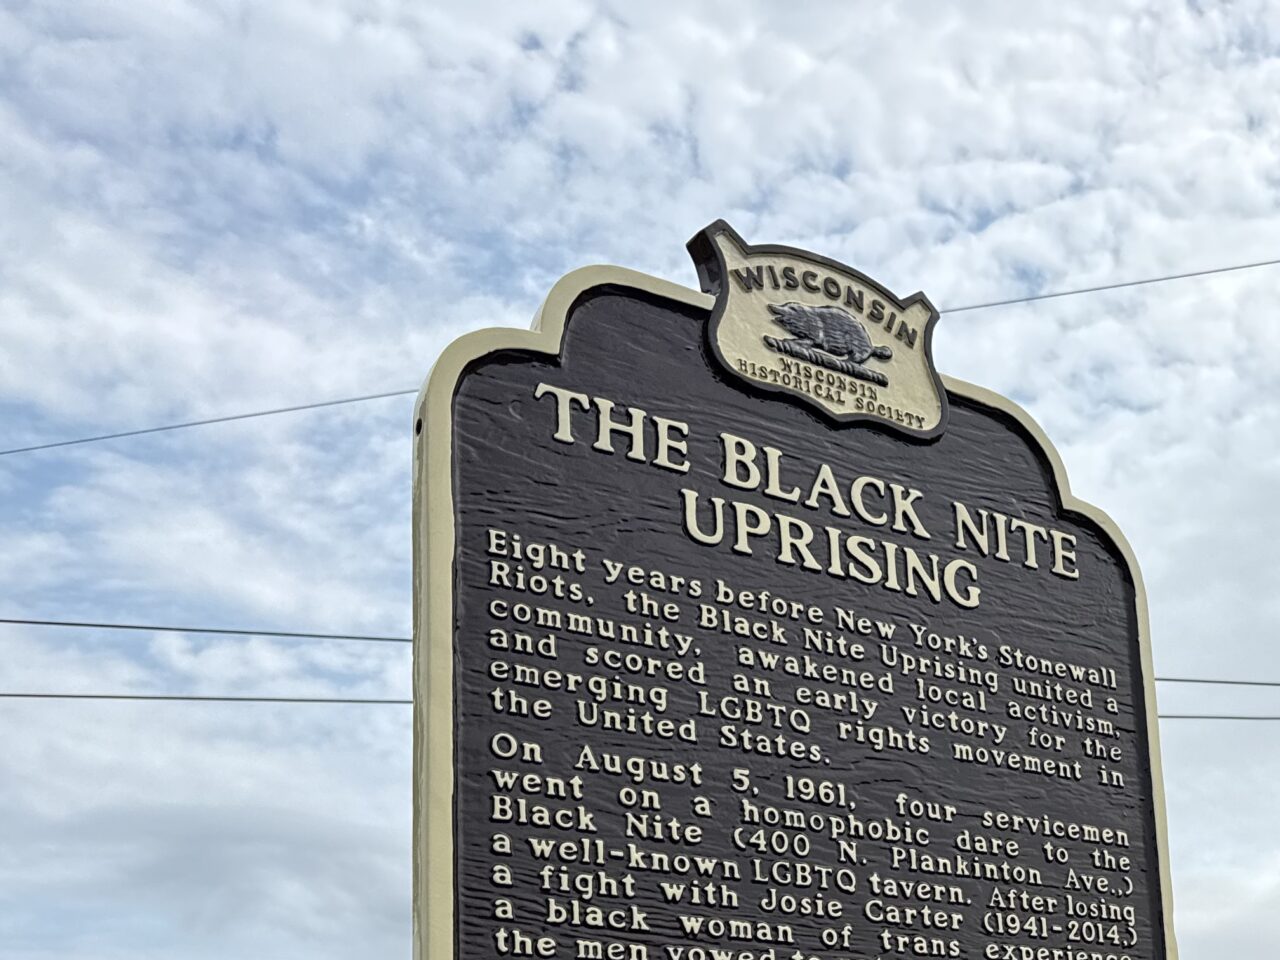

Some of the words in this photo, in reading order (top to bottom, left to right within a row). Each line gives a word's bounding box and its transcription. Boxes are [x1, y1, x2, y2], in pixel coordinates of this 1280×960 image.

[731, 265, 918, 350] WISCONSIN
[737, 358, 846, 405] HISTORICAL
[856, 397, 925, 429] SOCIETY
[779, 358, 878, 400] WISCONSIN
[534, 381, 691, 473] THE
[719, 431, 932, 539] BLACK
[952, 500, 1080, 579] NITE
[680, 487, 982, 608] UPRISING
[488, 528, 587, 572] Eight
[602, 558, 702, 597] years
[716, 578, 824, 623] before
[834, 606, 897, 640] New
[999, 644, 1118, 689] Stonewall
[489, 560, 594, 604] Riots,
[623, 589, 680, 621] the
[699, 603, 789, 645] Black
[802, 626, 865, 660] Nite
[880, 643, 999, 693] Uprising
[1012, 676, 1094, 708] united
[1106, 696, 1119, 714] a
[489, 628, 558, 658] and
[585, 646, 706, 685] scored
[732, 673, 772, 697] an
[796, 686, 879, 720] early
[901, 703, 1008, 744] victory
[1028, 726, 1067, 751] for
[1083, 736, 1122, 761] the
[490, 599, 702, 656] community,
[738, 646, 895, 694] awakened
[916, 677, 987, 711] local
[1007, 700, 1121, 738] activism,
[490, 660, 668, 712] emerging
[697, 690, 811, 733] LGBTQ
[838, 719, 931, 753] rights
[953, 742, 1082, 779] movement
[1099, 764, 1125, 787] in
[491, 686, 553, 718] the
[576, 699, 697, 742] United
[720, 724, 830, 764] States.
[491, 732, 543, 763] On
[574, 744, 703, 785] August
[732, 767, 759, 795] 5,
[785, 774, 857, 810] 1961,
[895, 792, 957, 822] four
[982, 810, 1130, 847] servicemen
[491, 769, 584, 799] went
[619, 786, 661, 809] on
[693, 795, 712, 817] a
[741, 797, 930, 845] homophobic
[956, 829, 1020, 857] dare
[1043, 841, 1069, 863] to
[1091, 847, 1131, 871] the
[492, 794, 598, 831] Black
[625, 811, 702, 843] Nite
[733, 827, 811, 857] (400
[837, 839, 868, 865] N.
[891, 845, 1043, 885] Plankinton
[492, 833, 512, 854] a
[528, 837, 741, 879] well-known
[753, 858, 857, 893] LGBTQ
[869, 871, 973, 905] tavern.
[989, 886, 1058, 913] After
[1065, 893, 1136, 927] losing
[492, 864, 513, 885] a
[539, 864, 636, 900] fight
[659, 881, 739, 908] with
[760, 887, 843, 917] Josie
[865, 899, 964, 930] Carter
[494, 898, 514, 919] a
[546, 897, 651, 931] black
[679, 915, 795, 943] woman
[821, 924, 853, 948] of
[880, 928, 961, 957] trans
